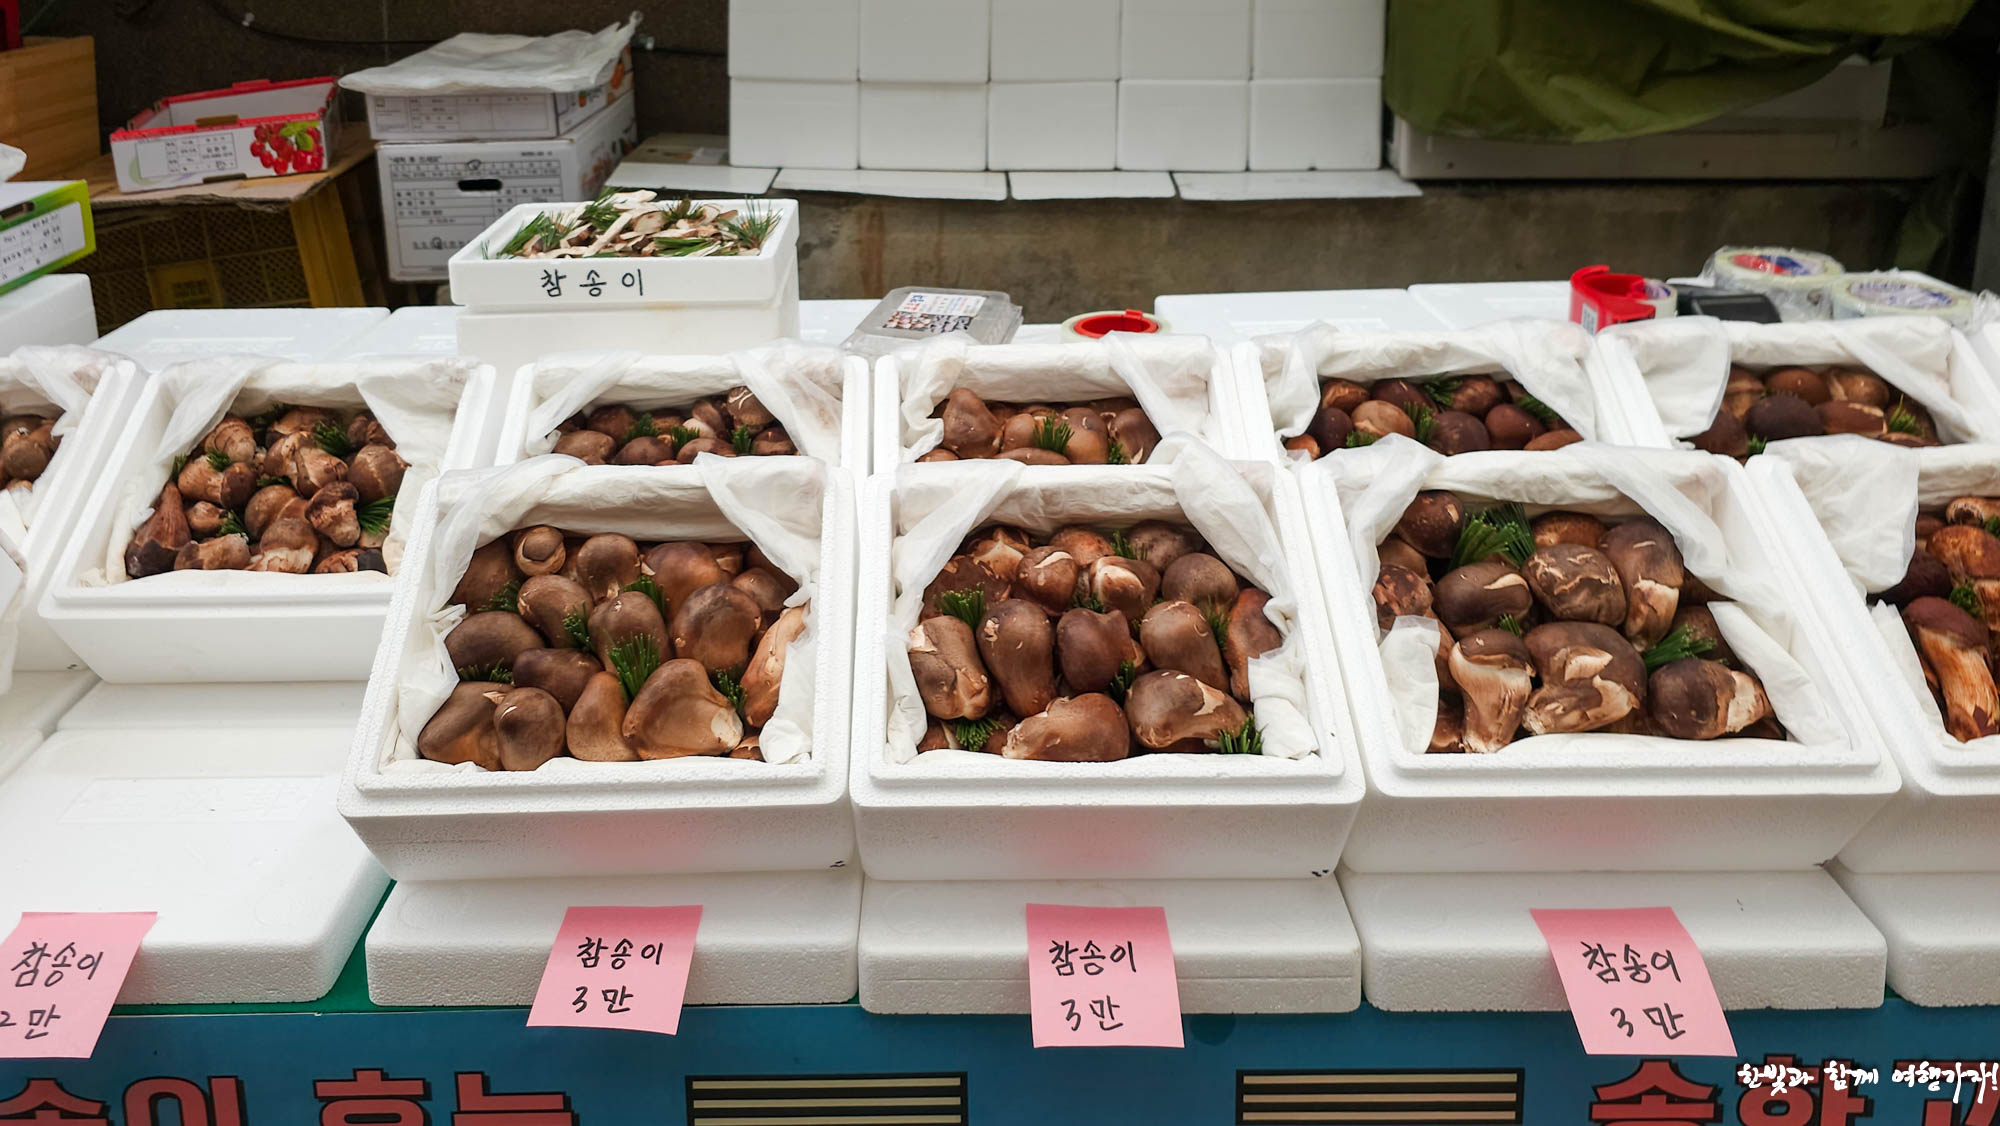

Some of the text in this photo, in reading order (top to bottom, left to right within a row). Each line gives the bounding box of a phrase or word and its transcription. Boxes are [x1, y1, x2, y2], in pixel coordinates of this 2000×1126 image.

[540, 268, 644, 298] 참송이
[10, 940, 105, 989] 참송이
[575, 936, 665, 971] 참송이
[1048, 939, 1138, 977] 참송이
[1579, 940, 1683, 985] 참송이
